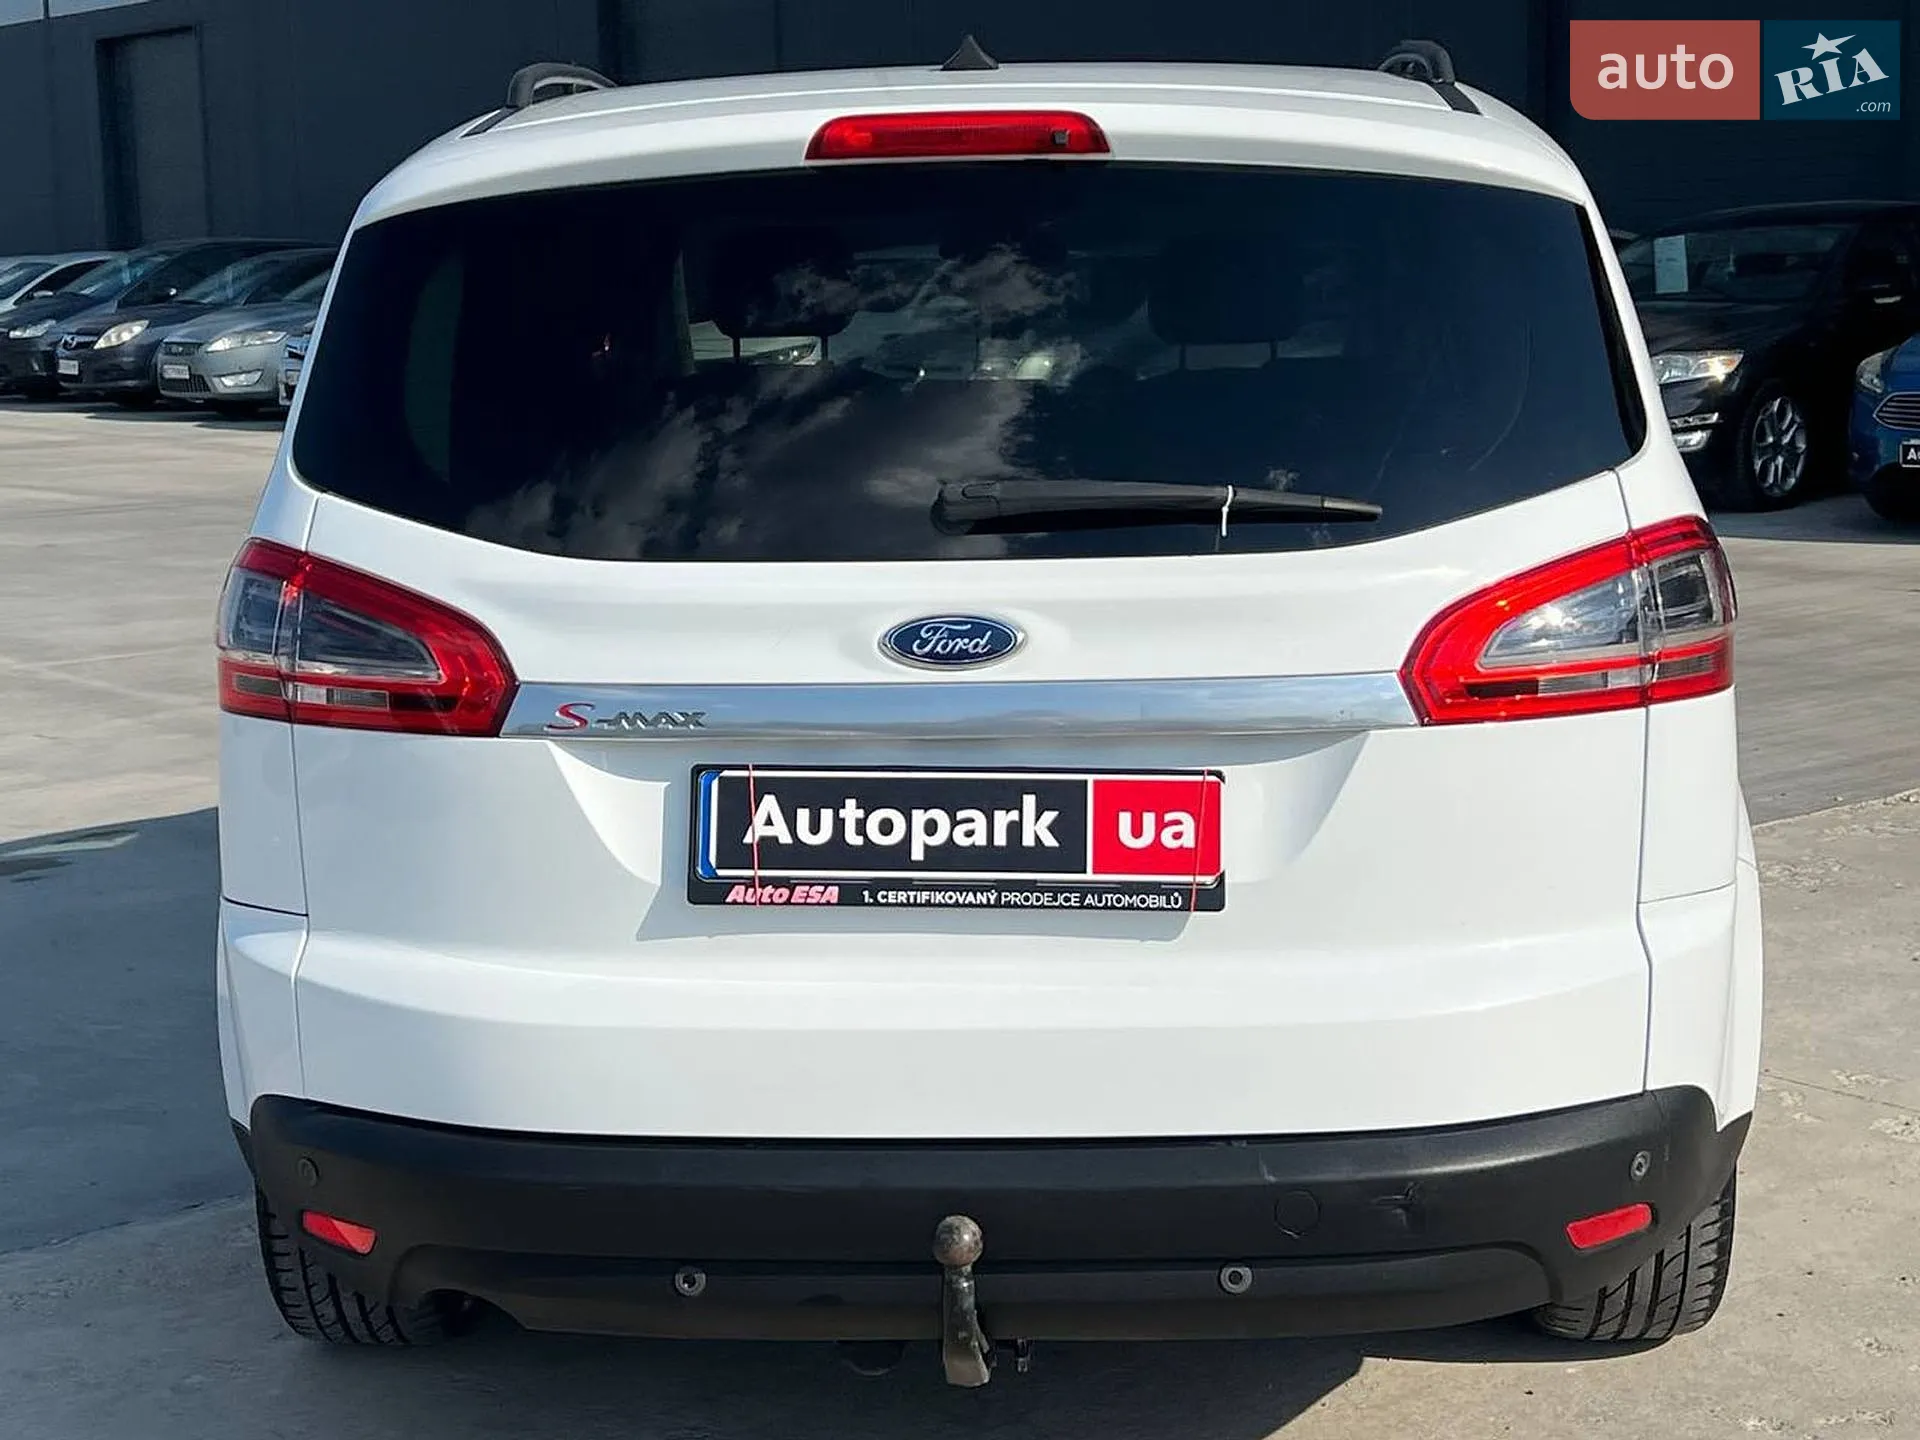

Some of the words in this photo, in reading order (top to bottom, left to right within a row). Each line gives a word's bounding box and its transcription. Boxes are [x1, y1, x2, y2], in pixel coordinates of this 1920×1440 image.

[912, 622, 992, 655] Ford
[544, 702, 706, 731] S-MAX
[743, 794, 1060, 861] Autopark
[1117, 808, 1196, 849] ua
[726, 884, 787, 903] Auto
[791, 885, 839, 904] ESA
[863, 890, 873, 903] 1.
[876, 890, 998, 905] CERTIFIKOVANÝ
[1001, 892, 1080, 907] PRODEJCE
[1083, 891, 1182, 909] AUTOMOBILŮ
